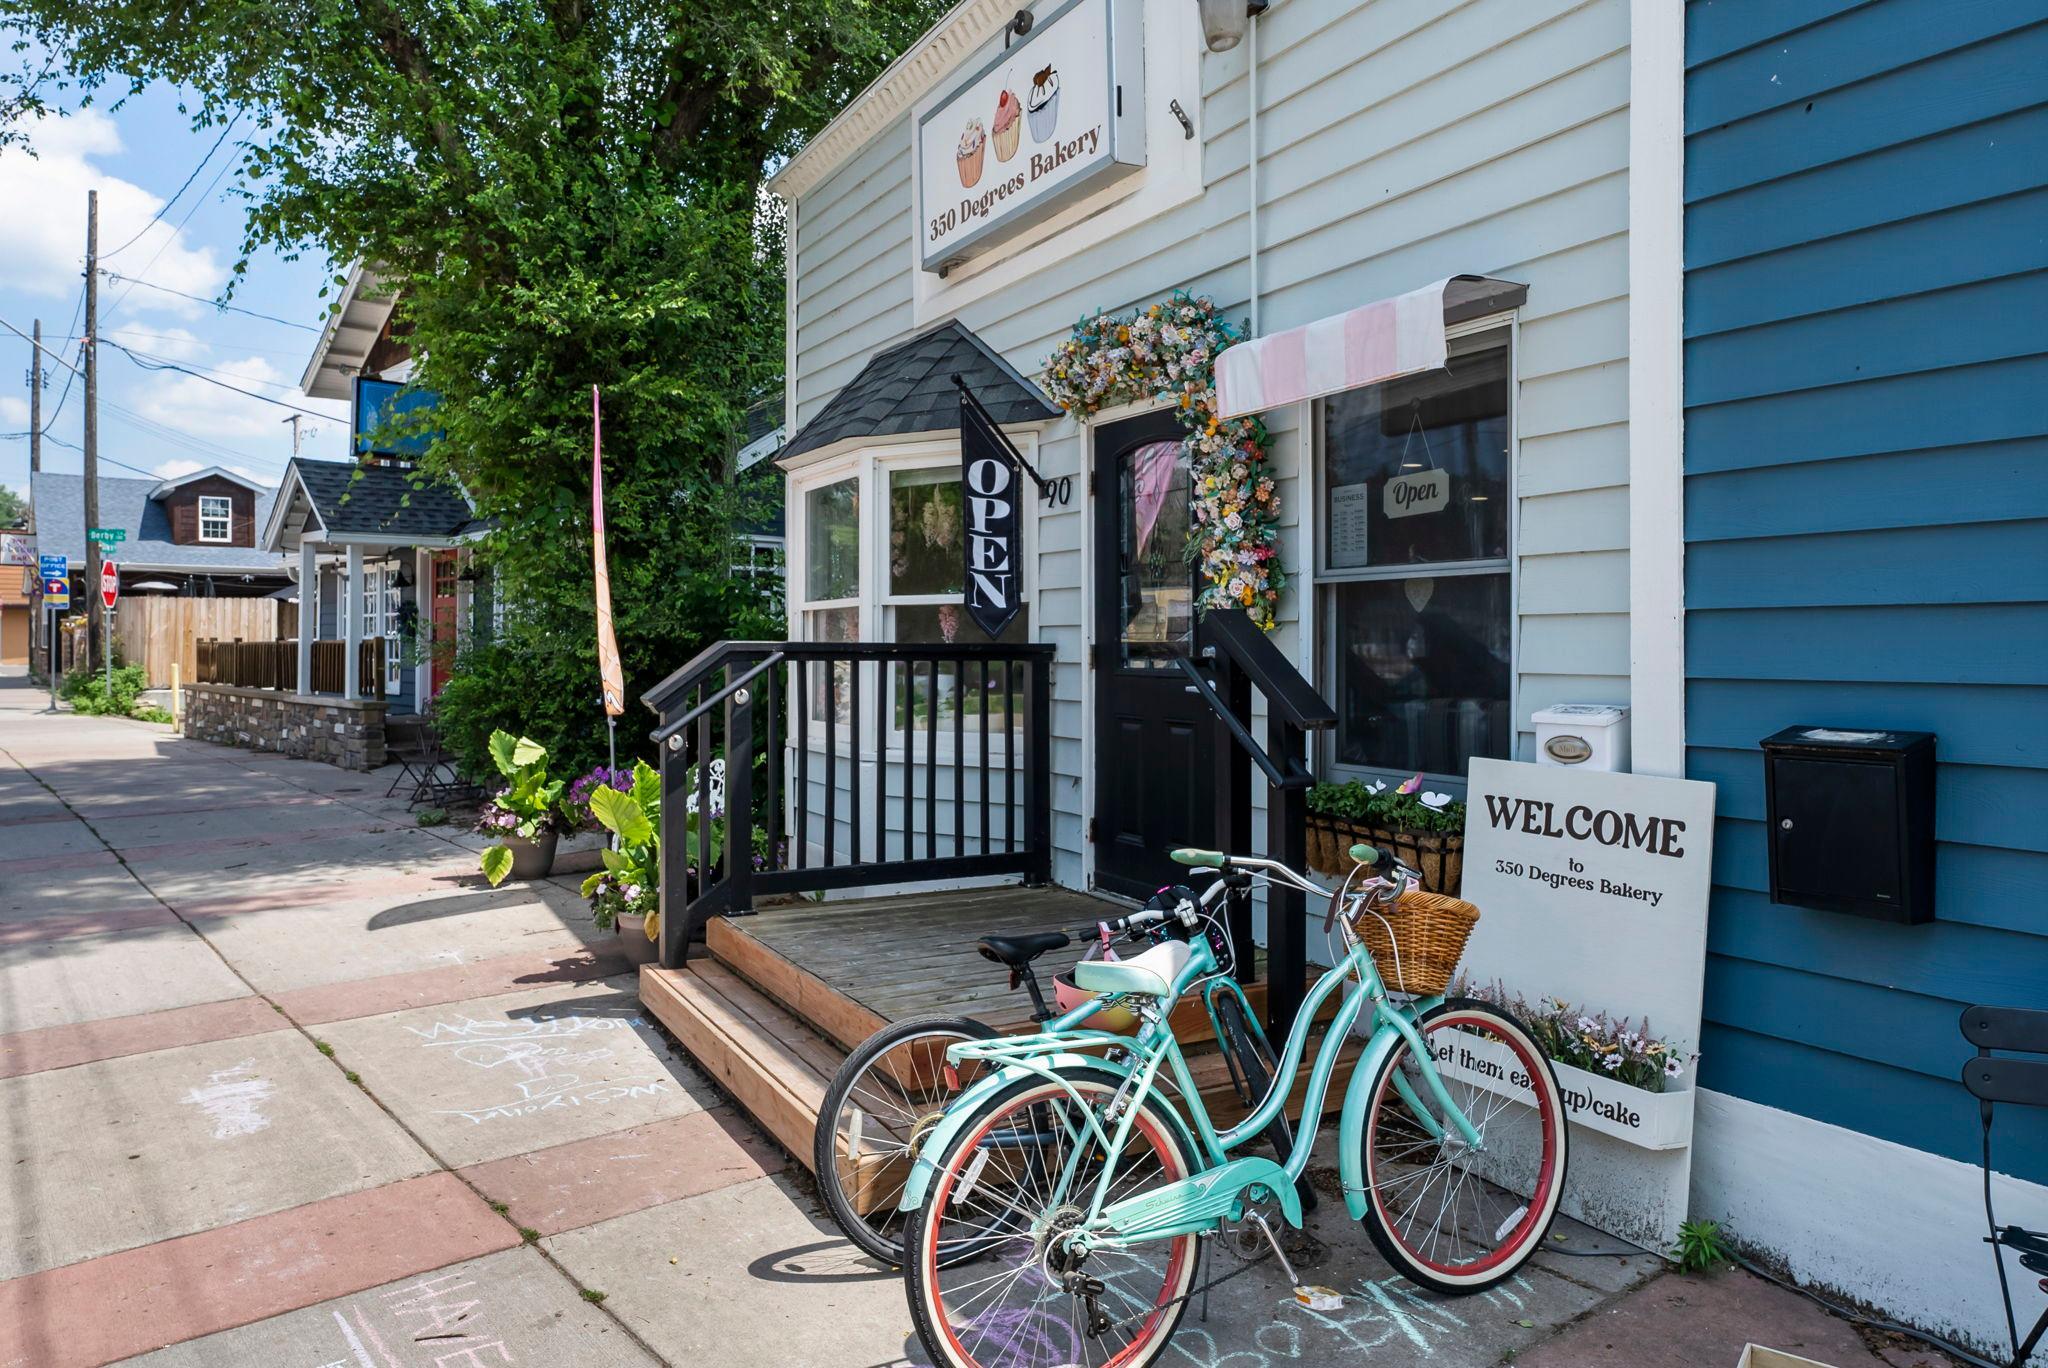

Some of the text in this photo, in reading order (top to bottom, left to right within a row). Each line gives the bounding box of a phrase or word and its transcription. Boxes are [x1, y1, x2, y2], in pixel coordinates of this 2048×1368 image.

[930, 124, 1102, 242] 350 Degrees Bakery
[1046, 476, 1071, 508] 90
[1333, 493, 1365, 503] BUSINESS
[1392, 481, 1439, 510] Open
[91, 531, 114, 541] Derby
[967, 458, 1012, 609] OPEN
[101, 575, 117, 593] STOP
[1484, 794, 1687, 859] WELCOME
[1568, 857, 1584, 874] to
[1495, 859, 1664, 907] 350 Degrees Bakery
[1459, 1048, 1504, 1081] them
[1510, 1070, 1536, 1092] ea
[1559, 1086, 1640, 1128] up)cake
